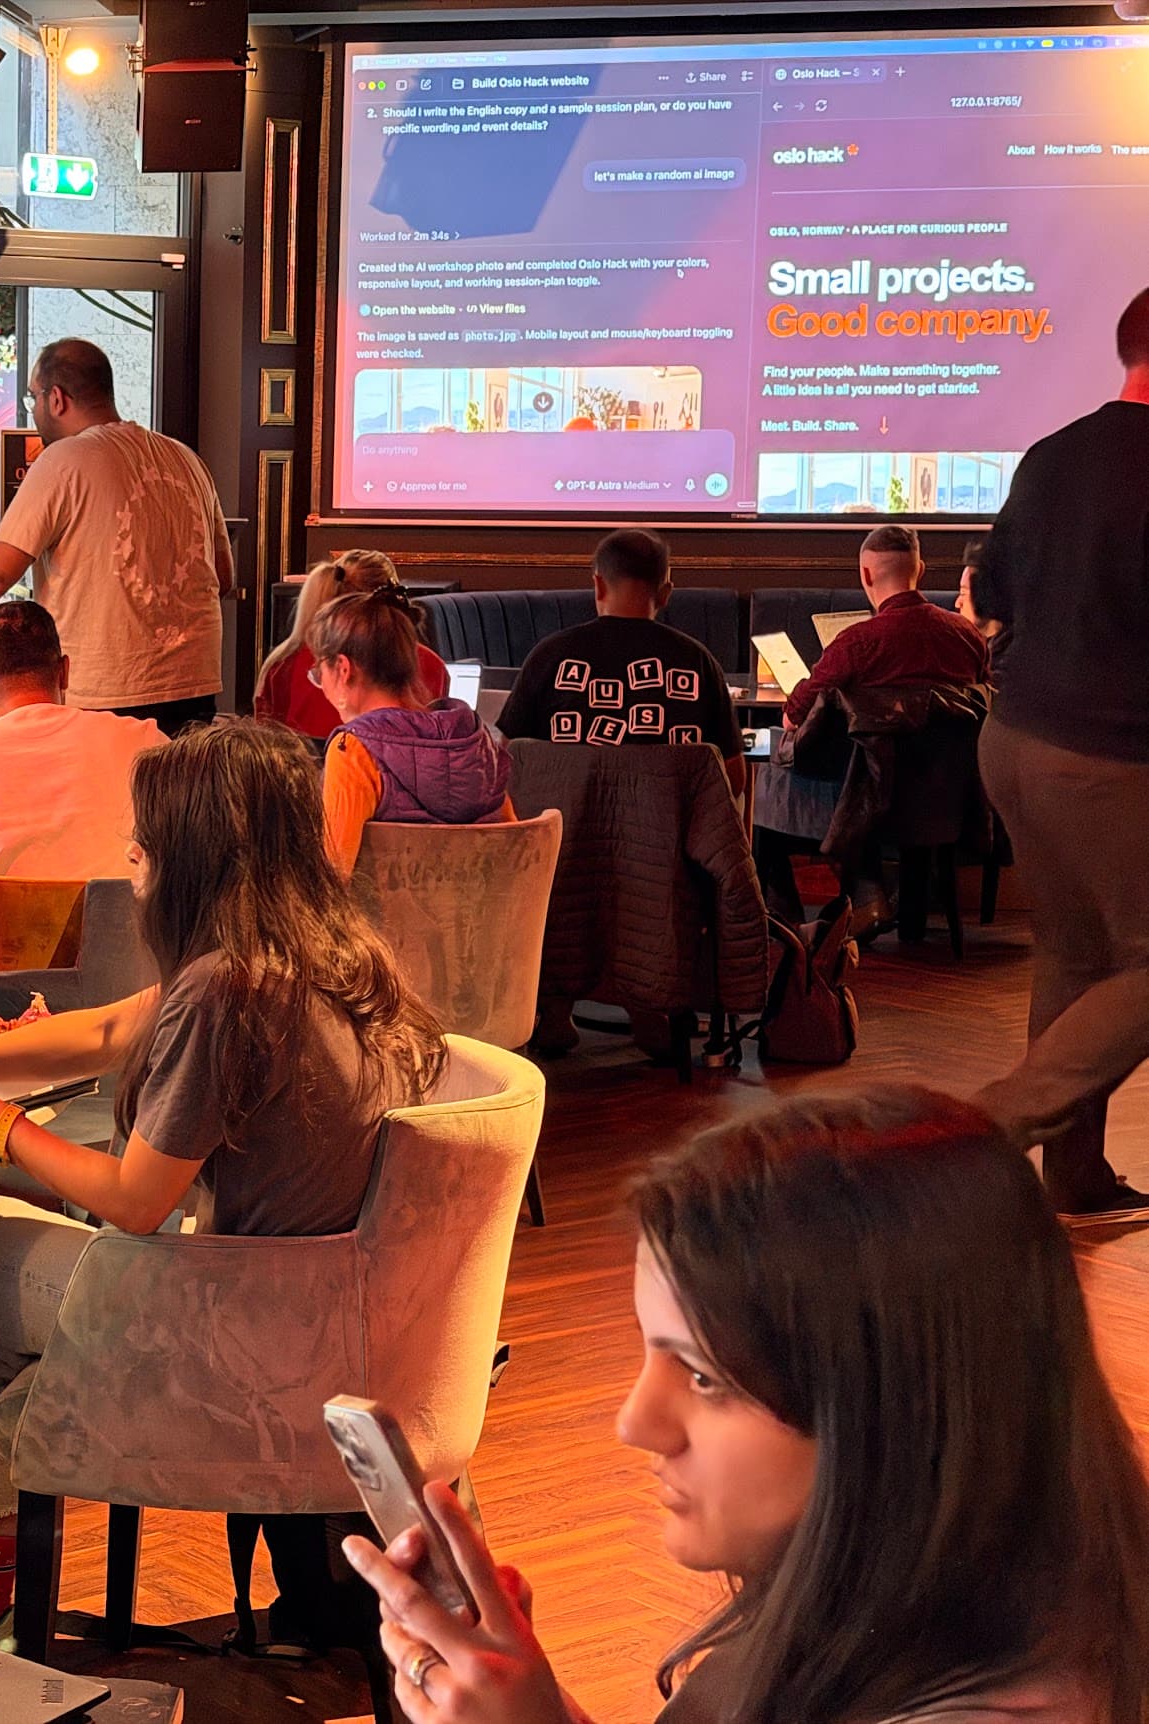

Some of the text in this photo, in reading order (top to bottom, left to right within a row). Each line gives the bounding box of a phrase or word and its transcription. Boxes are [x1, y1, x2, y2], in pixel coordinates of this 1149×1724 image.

[699, 72, 726, 82] Share
[792, 69, 814, 79] Oslo
[816, 68, 840, 78] Hack
[472, 76, 589, 89] Build Oslo Hack website
[951, 96, 1021, 107] 127.0.0.1:8765/
[367, 108, 377, 118] 2.
[383, 107, 416, 118] Should
[423, 107, 447, 117] write
[449, 106, 465, 117] the
[467, 105, 502, 118] English
[503, 106, 528, 117] copy
[529, 104, 548, 115] and
[549, 105, 556, 114] a
[558, 103, 593, 114] sample
[595, 102, 632, 113] session
[634, 101, 657, 113] plan,
[660, 102, 671, 111] or
[672, 100, 686, 111] do
[687, 102, 706, 112] you
[708, 100, 731, 110] have
[383, 120, 548, 135] specific wording and event details?
[773, 147, 844, 164] oslo hack
[1007, 145, 1035, 155] About
[1044, 144, 1102, 155] How it works
[1111, 145, 1129, 155] The
[594, 171, 615, 182] let's
[617, 171, 643, 181] make
[645, 172, 652, 181] a
[654, 170, 691, 180] random
[704, 169, 734, 181] image
[360, 231, 449, 242] Worked for 2m 34s
[769, 227, 799, 237] OSLO,
[802, 226, 844, 236] NORWAY
[851, 225, 859, 235] A
[861, 225, 894, 235] PLACE
[897, 224, 917, 234] FOR
[919, 224, 965, 234] CURIOUS
[967, 223, 1007, 233] PEOPLE
[359, 258, 709, 273] Created the AI workshop photo and completed Oslo Hack with your colors,
[358, 276, 600, 290] responsive layout, and working session-plan toggle.
[768, 259, 1034, 301] Small projects.
[372, 305, 398, 317] Open
[400, 305, 416, 315] the
[418, 304, 455, 315] website
[479, 304, 503, 314] View
[505, 303, 525, 314] files
[766, 303, 1053, 341] Good company.
[357, 332, 375, 342] The
[377, 332, 405, 343] image
[407, 331, 416, 341] is
[418, 331, 446, 341] saved
[447, 332, 459, 341] as
[525, 329, 557, 340] Mobile
[559, 330, 589, 341] layout
[590, 329, 609, 339] and
[611, 328, 691, 340] mouse/keyboard
[692, 327, 733, 340] toggling
[356, 348, 423, 359] were checked.
[763, 364, 1000, 380] Find your people. Make something together.
[762, 382, 979, 398] A little idea is all you need to get started.
[761, 420, 859, 432] Meet. Build. Share.
[400, 481, 467, 492] Approve for me
[597, 481, 621, 490] Astra
[623, 481, 659, 490] Medium
